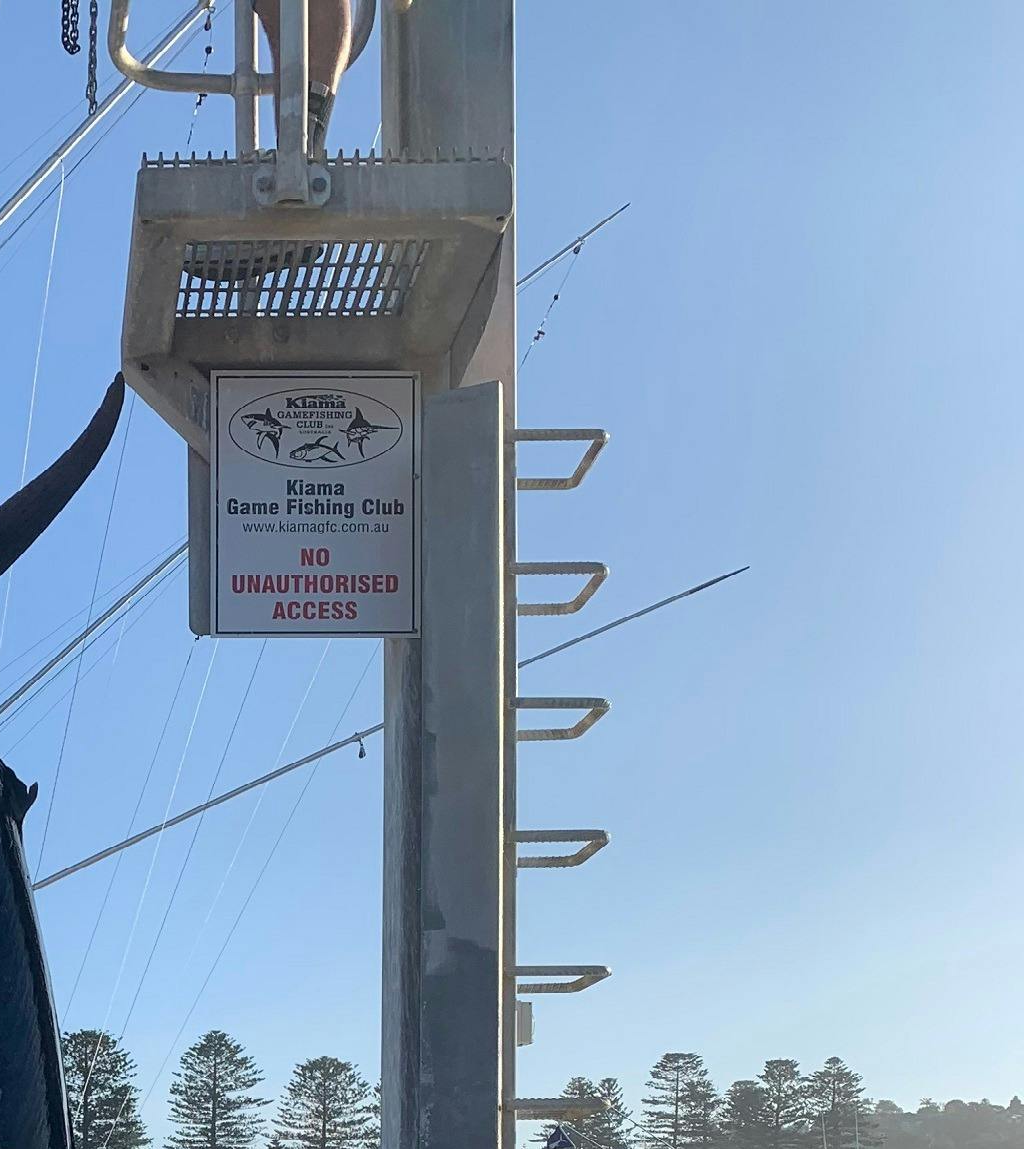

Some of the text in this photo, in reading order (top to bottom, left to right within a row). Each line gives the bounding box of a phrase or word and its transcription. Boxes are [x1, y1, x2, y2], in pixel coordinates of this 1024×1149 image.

[285, 398, 346, 408] Kiama
[277, 411, 353, 419] GAMEFISHING
[296, 420, 323, 428] CLUB
[286, 480, 345, 496] Kiama
[227, 498, 404, 518] Game Fishing Club
[242, 520, 389, 535] www.kiamagfc.com.au
[300, 548, 330, 566] NO
[232, 574, 399, 594] UNAUTHORISED
[272, 601, 358, 620] ACCESS
